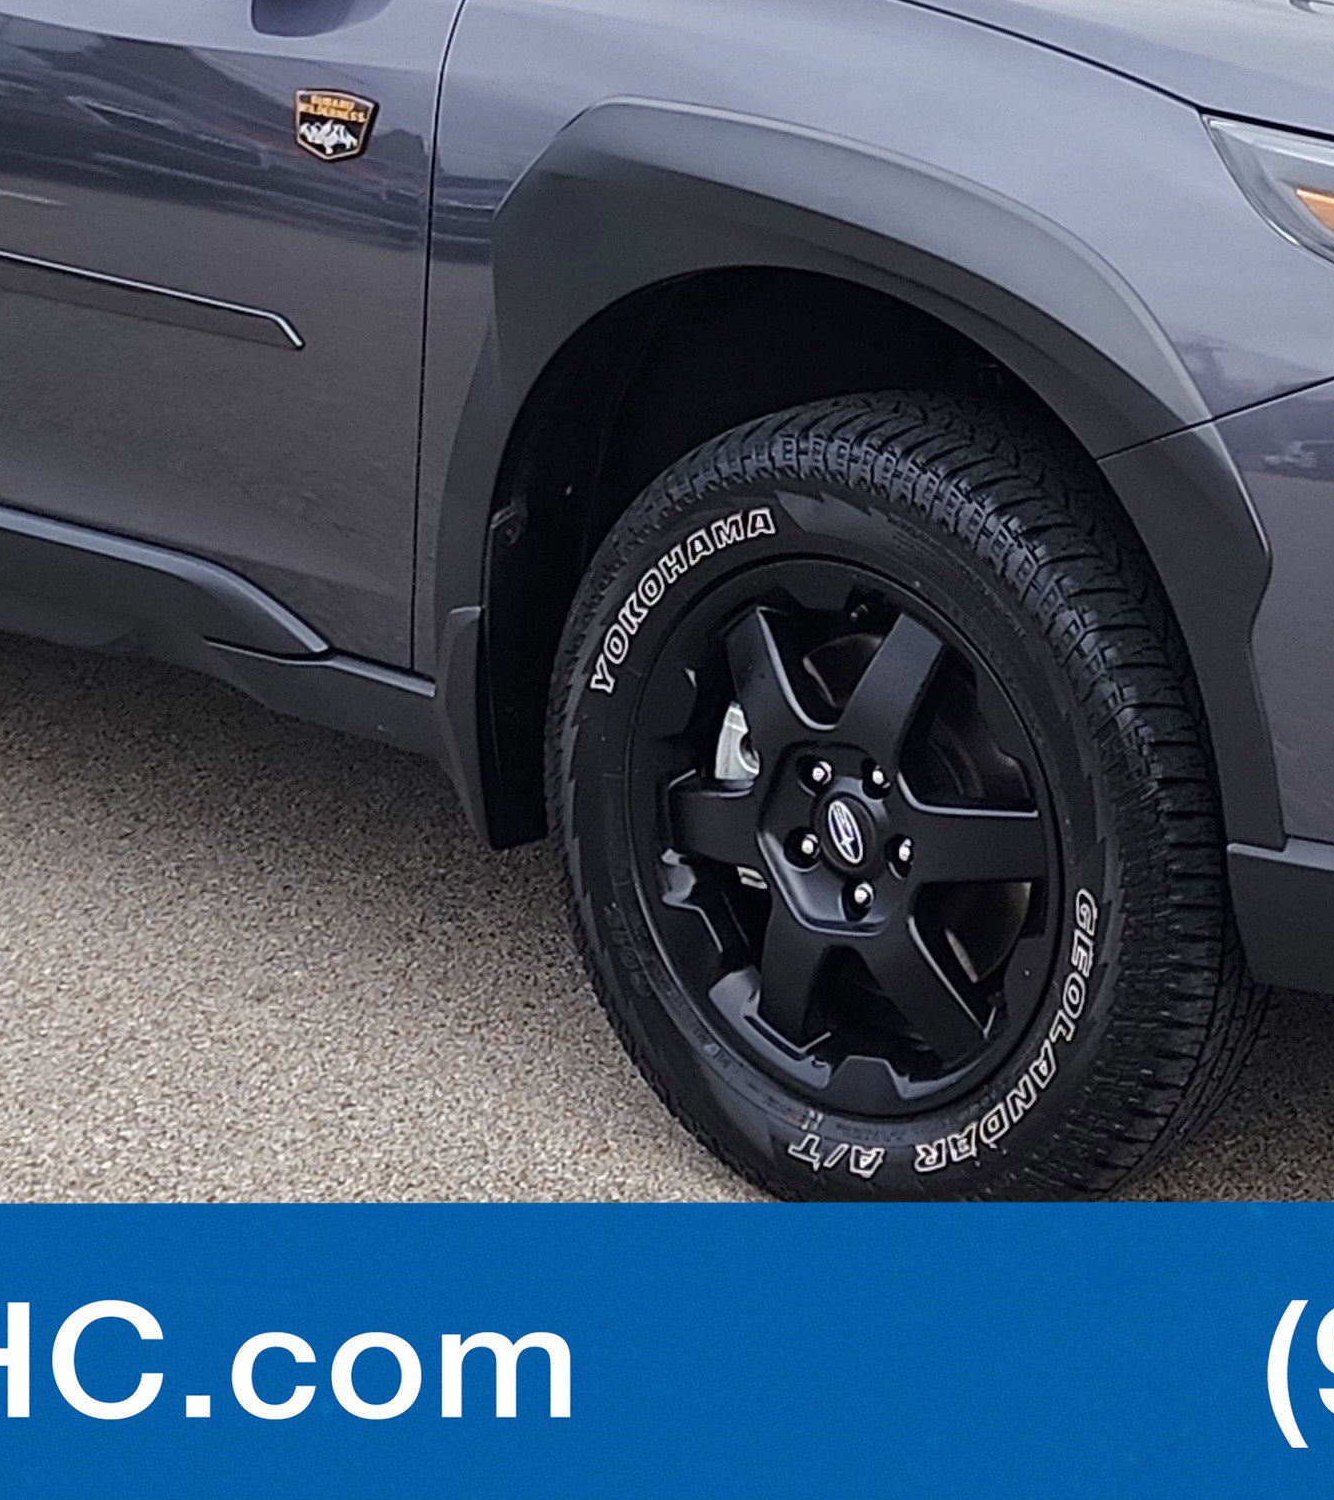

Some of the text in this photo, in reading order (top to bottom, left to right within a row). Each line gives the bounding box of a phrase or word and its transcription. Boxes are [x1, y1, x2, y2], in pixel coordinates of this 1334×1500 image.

[590, 507, 776, 697] YOKOHAMA
[787, 888, 1098, 1179] GEOLANDAR A/T
